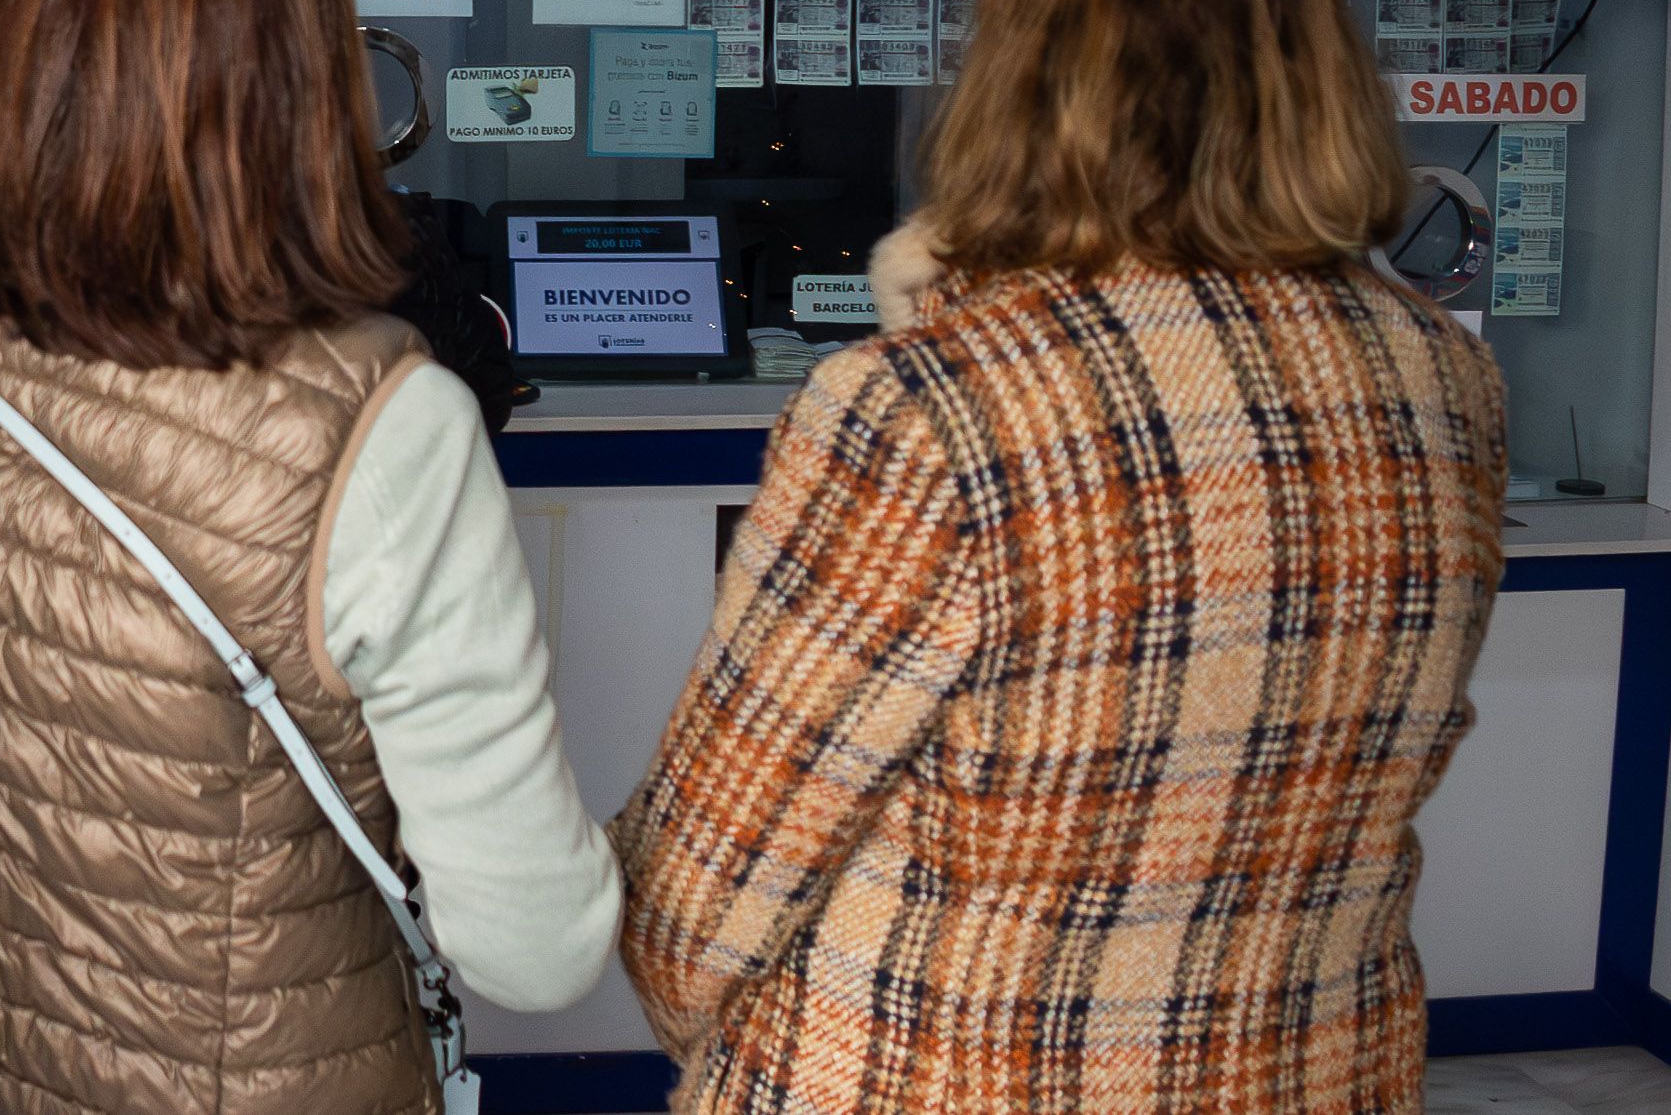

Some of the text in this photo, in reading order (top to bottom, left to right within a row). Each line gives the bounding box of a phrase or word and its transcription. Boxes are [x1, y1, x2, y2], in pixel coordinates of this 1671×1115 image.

[450, 68, 572, 81] ADMITIMOS TARJETA
[666, 71, 699, 81] Bizum
[1409, 80, 1578, 115] SABADO
[449, 126, 574, 137] PAGO MINIMO 10 EUROS
[584, 238, 643, 248] 20,00 EUR
[796, 280, 855, 293] LOTERÍA
[544, 289, 692, 306] BIENVENIDO
[812, 302, 877, 314] BARCELO
[544, 313, 693, 323] ES UN PLACER ATENDERLE
